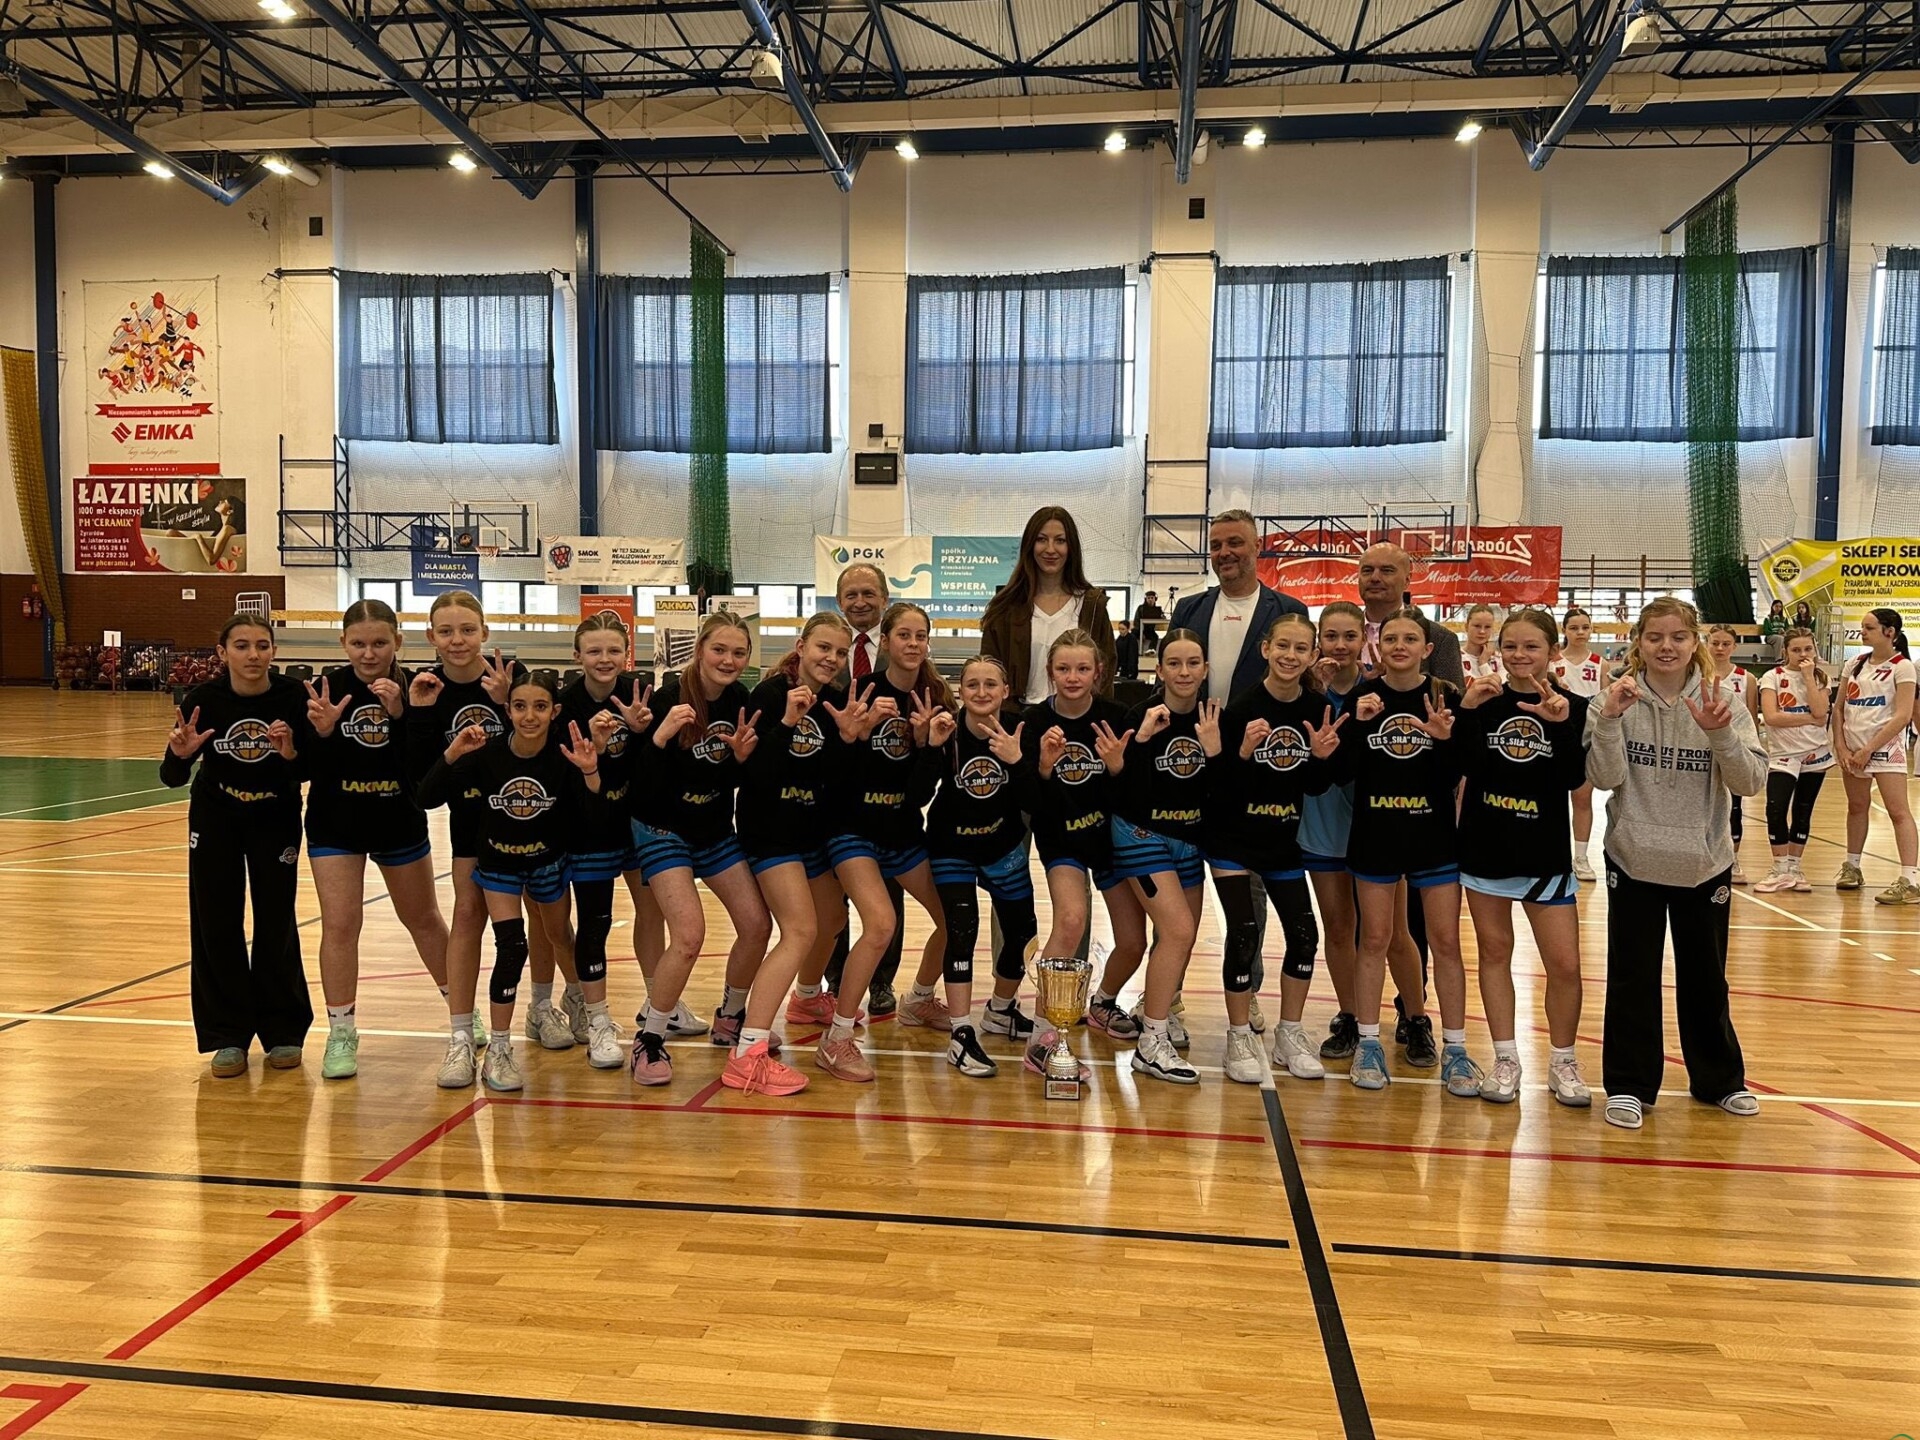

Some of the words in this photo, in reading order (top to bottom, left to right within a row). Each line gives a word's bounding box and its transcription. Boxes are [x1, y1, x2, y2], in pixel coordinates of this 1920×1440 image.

[134, 424, 194, 440] EMKA
[78, 482, 199, 504] ŁAZIENKI
[78, 506, 94, 515] 1000
[108, 506, 145, 517] ekspozycji
[79, 518, 91, 527] PH
[853, 548, 885, 559] PGK
[941, 547, 966, 555] spółka
[1842, 545, 1888, 558] SKLEP
[1891, 545, 1896, 558] I
[941, 555, 1000, 564] PRZYJAZNA
[439, 563, 467, 571] MIASTA
[420, 571, 474, 580] MIESZKAŃCÓW
[1426, 570, 1462, 583] Miasto
[941, 582, 987, 591] WSPIERA
[1844, 579, 1873, 588] ŻYRARDÓW
[655, 601, 696, 611] LAKMA
[943, 603, 954, 612] to
[1582, 668, 1597, 682] 31
[1872, 669, 1893, 682] 77
[1627, 740, 1656, 754] SIŁA
[1661, 746, 1711, 759] USTROŃ
[342, 780, 400, 793] LAKMA
[1369, 795, 1429, 809] LAKMA
[1483, 791, 1539, 813] LAKMA
[1151, 808, 1201, 821] LAKMA
[1247, 802, 1297, 817] LAKMA
[1065, 810, 1104, 831] LAKMA
